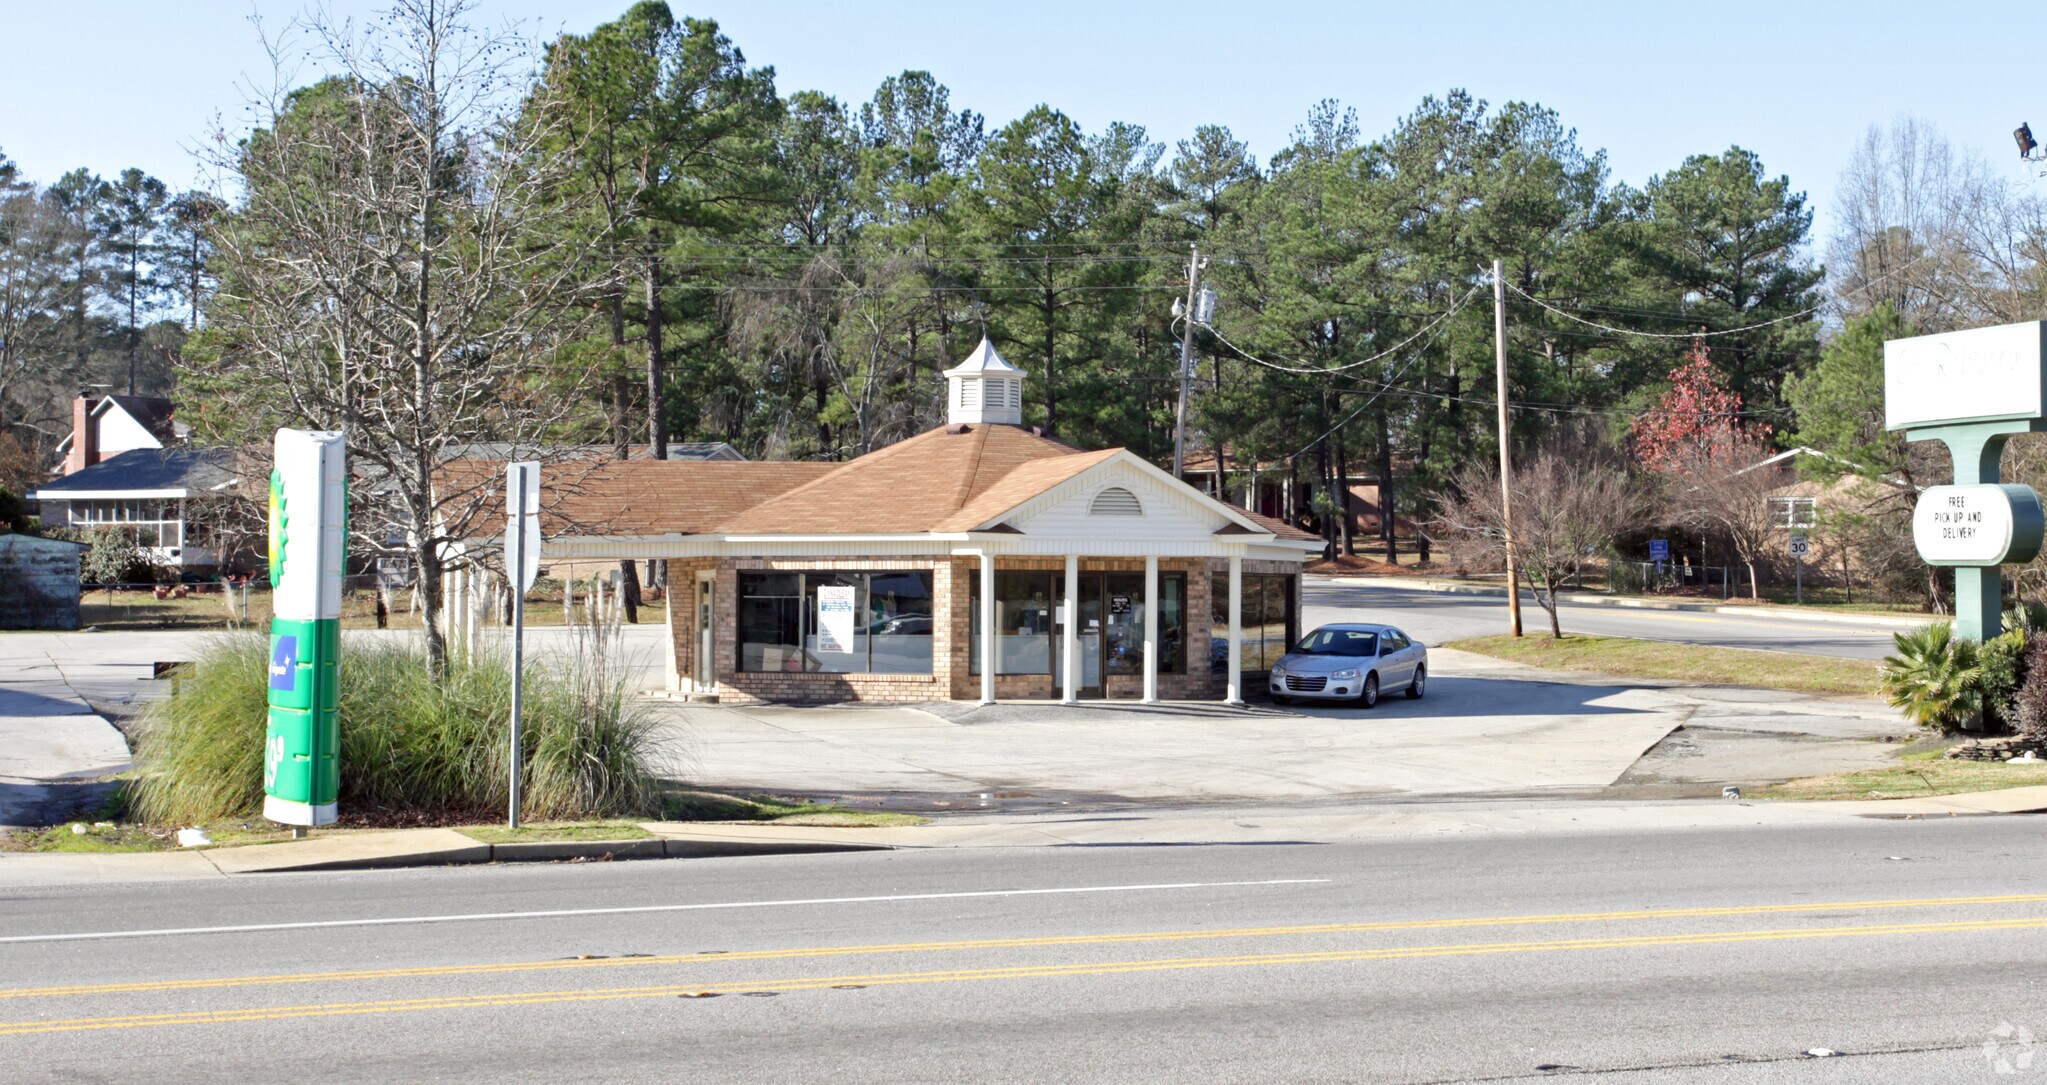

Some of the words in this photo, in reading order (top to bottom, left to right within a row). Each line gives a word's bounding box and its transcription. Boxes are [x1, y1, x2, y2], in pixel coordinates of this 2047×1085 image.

[1949, 496, 1965, 508] FREE
[1935, 512, 1950, 523] PICK
[1953, 511, 1964, 523] UP
[1967, 511, 1982, 523] AND
[1943, 527, 1976, 539] DELIVERY
[1791, 543, 1806, 552] 30
